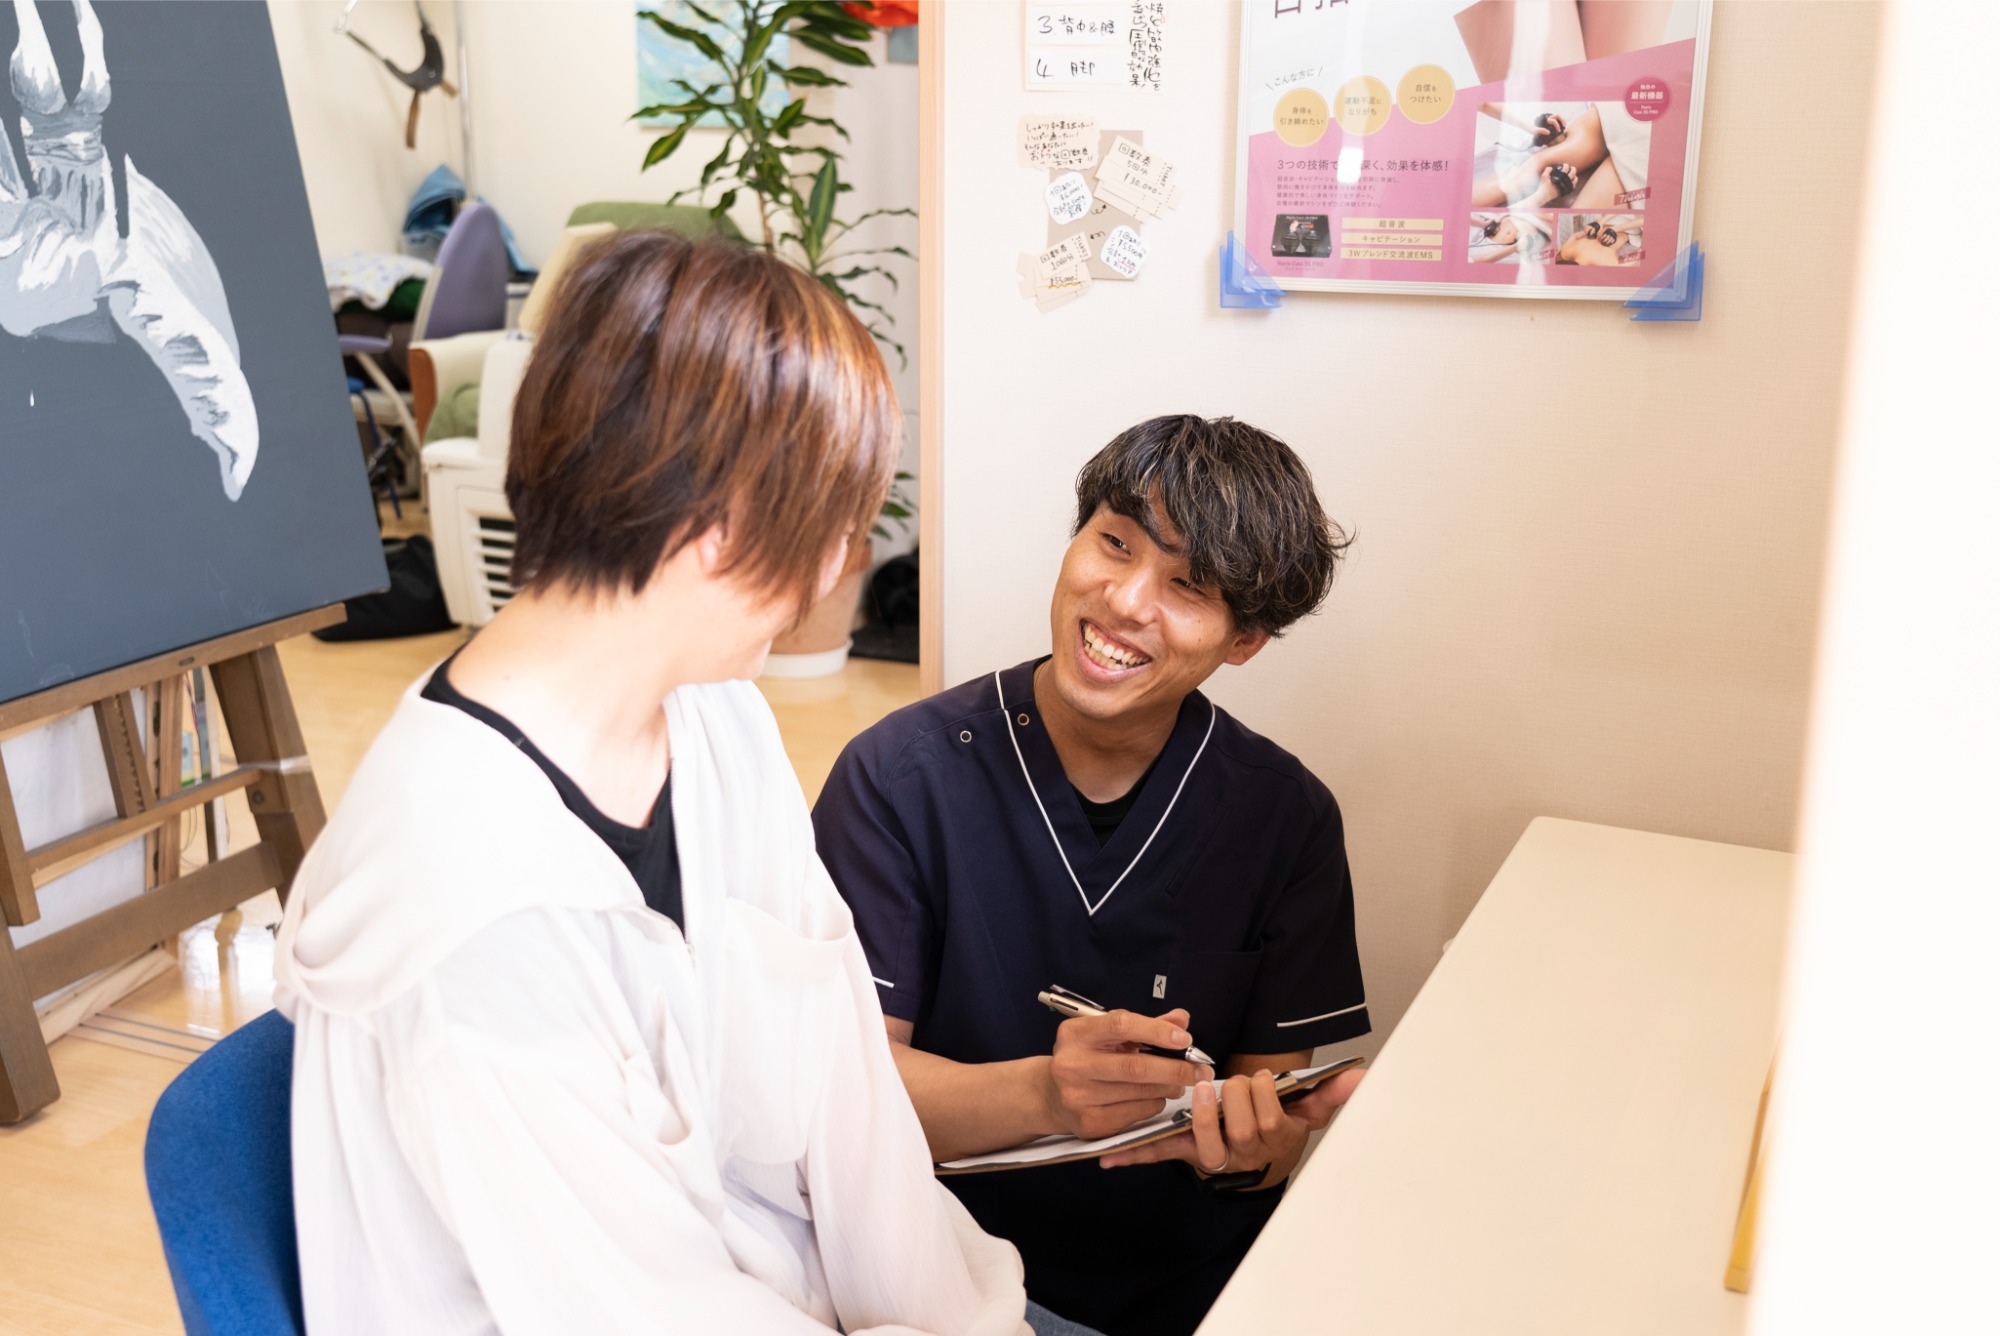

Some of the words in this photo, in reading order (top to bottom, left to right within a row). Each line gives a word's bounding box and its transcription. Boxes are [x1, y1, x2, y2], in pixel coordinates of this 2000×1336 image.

[1274, 68, 1315, 87] こんな方に
[1410, 96, 1442, 104] つけたい
[1279, 117, 1324, 126] 引き締めたい
[1363, 235, 1421, 243] キャビテーション
